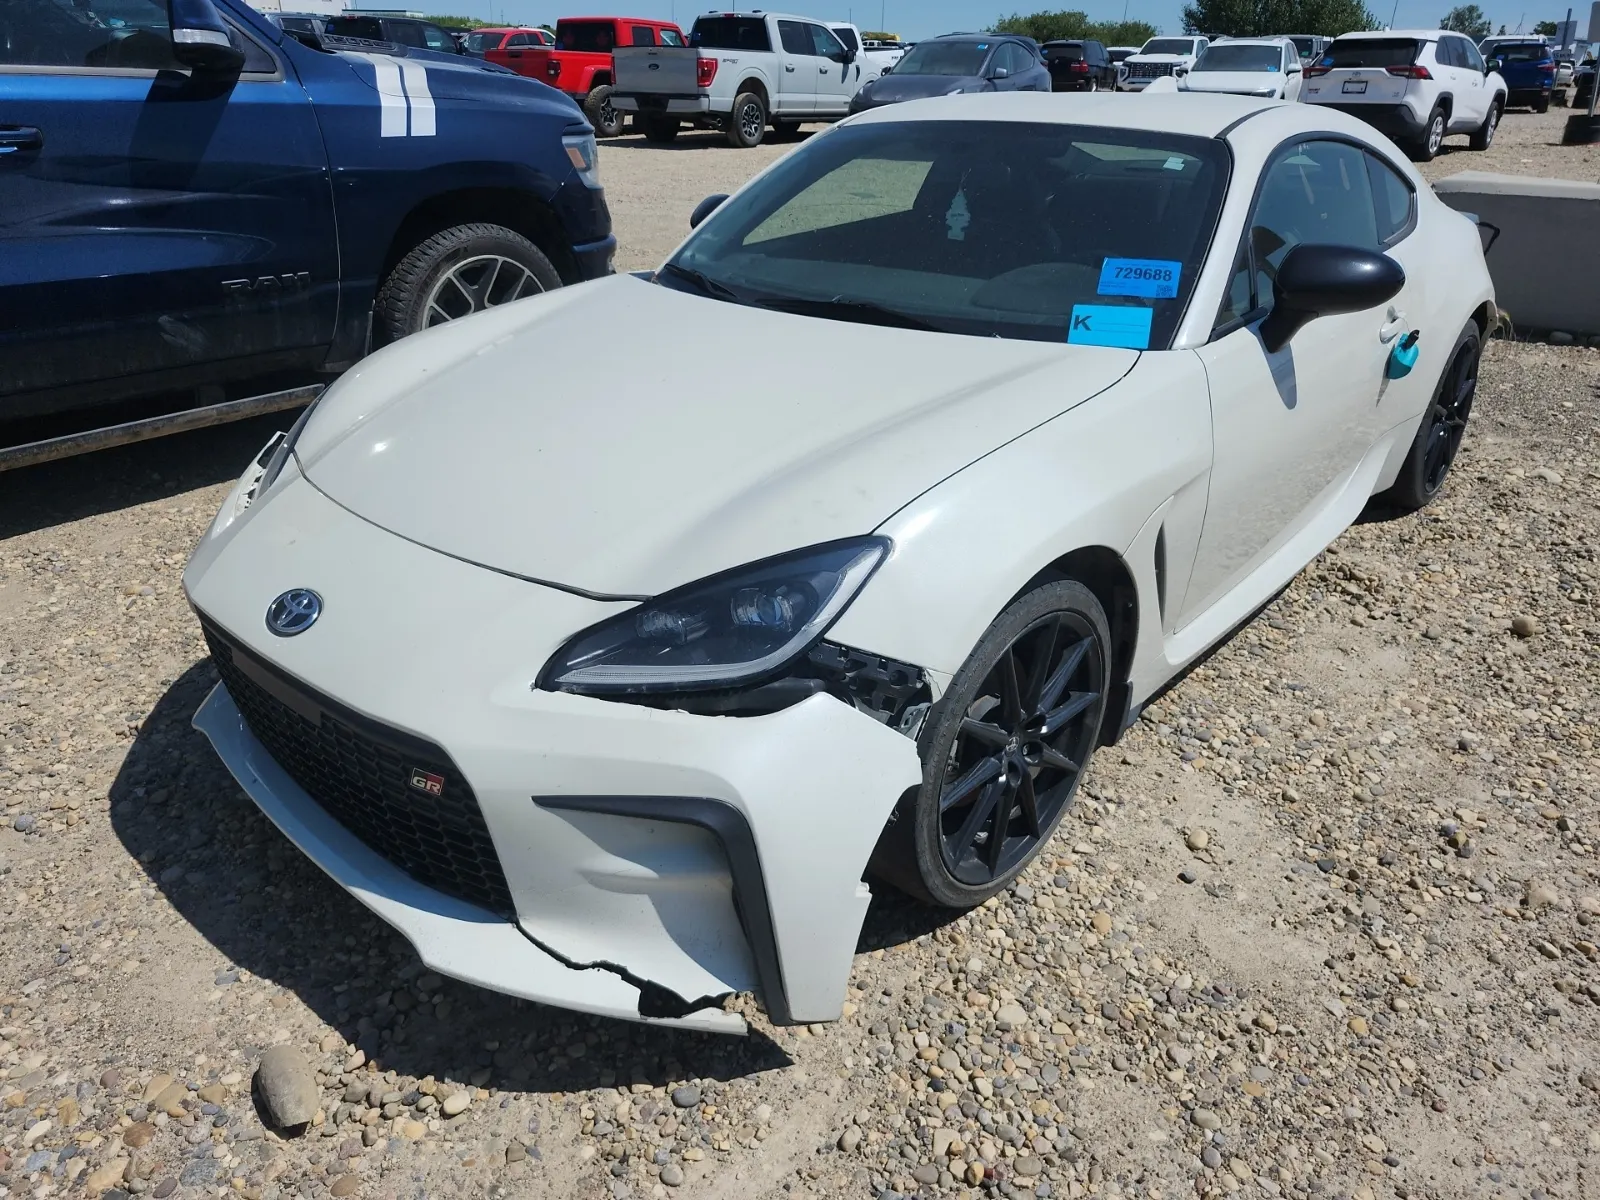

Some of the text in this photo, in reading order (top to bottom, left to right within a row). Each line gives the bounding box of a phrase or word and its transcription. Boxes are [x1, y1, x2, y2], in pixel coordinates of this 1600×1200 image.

[221, 271, 310, 294] RAM
[1114, 267, 1172, 282] 729688
[1073, 315, 1092, 331] K
[412, 776, 441, 793] GR
